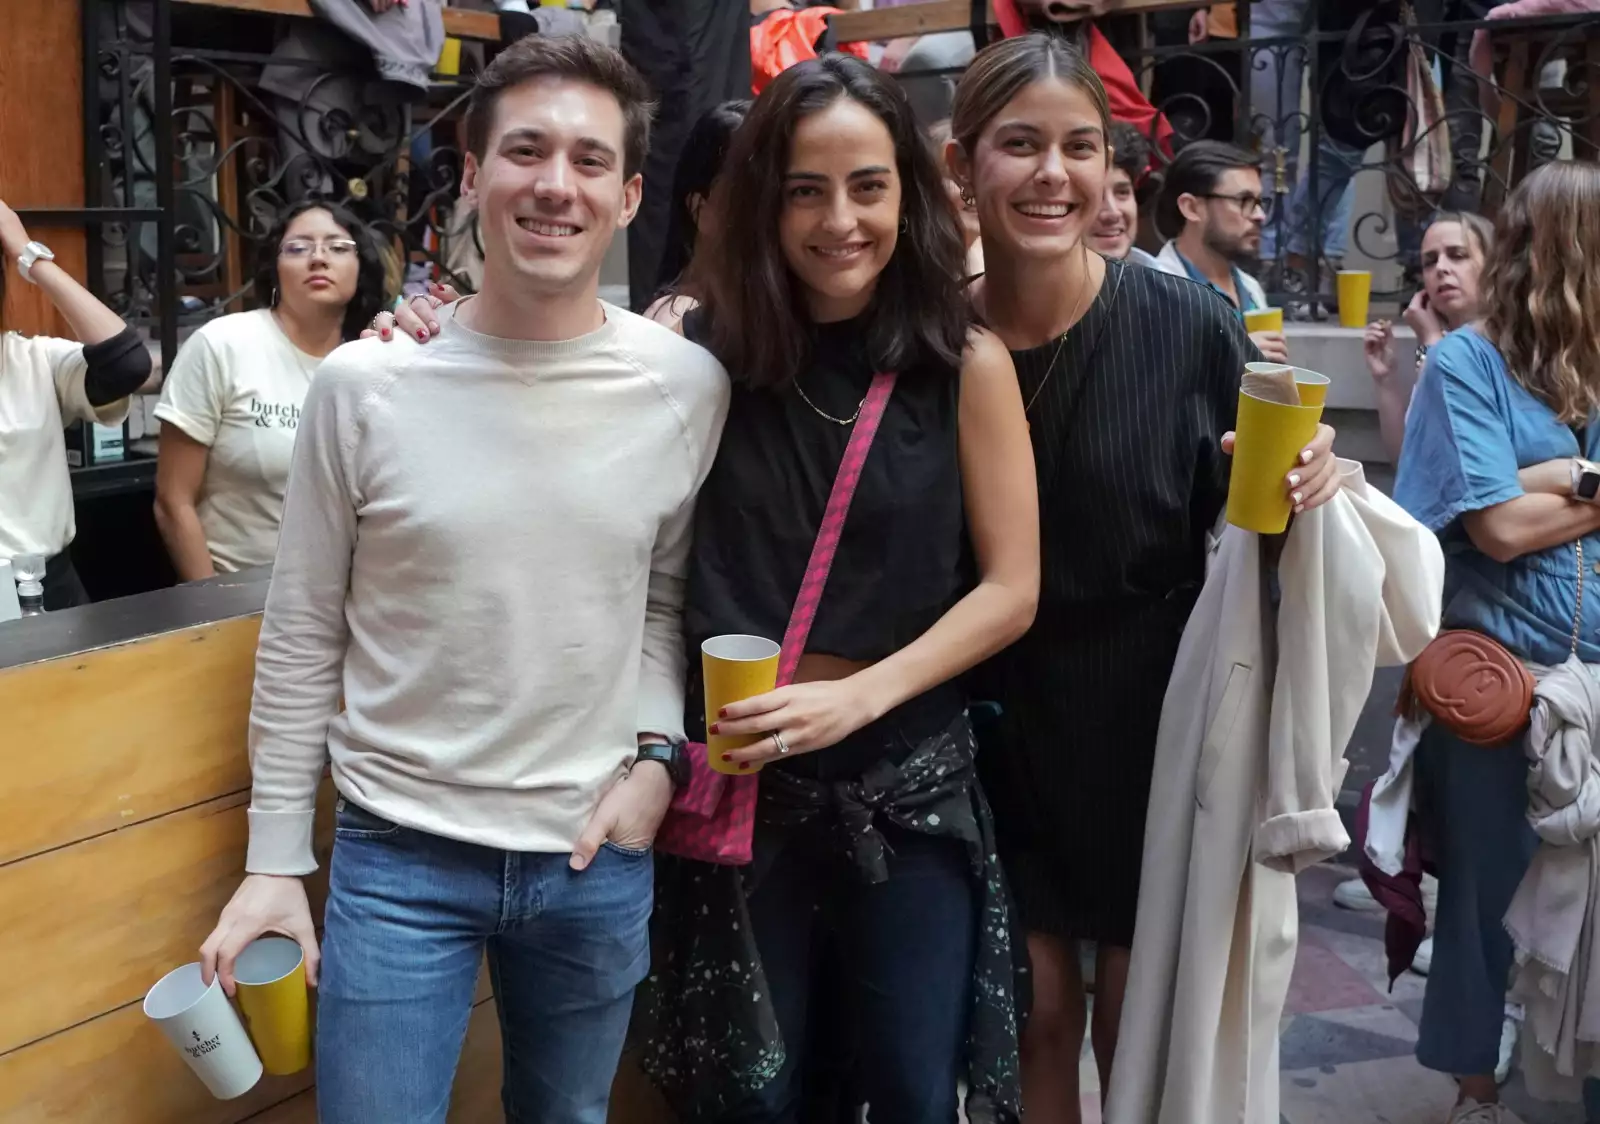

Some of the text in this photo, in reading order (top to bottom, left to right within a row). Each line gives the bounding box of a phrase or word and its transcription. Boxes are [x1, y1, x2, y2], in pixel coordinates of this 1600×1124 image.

[251, 397, 300, 418] butch
[255, 413, 296, 429] & so
[184, 1033, 220, 1053] butcher
[201, 1040, 221, 1055] sons
